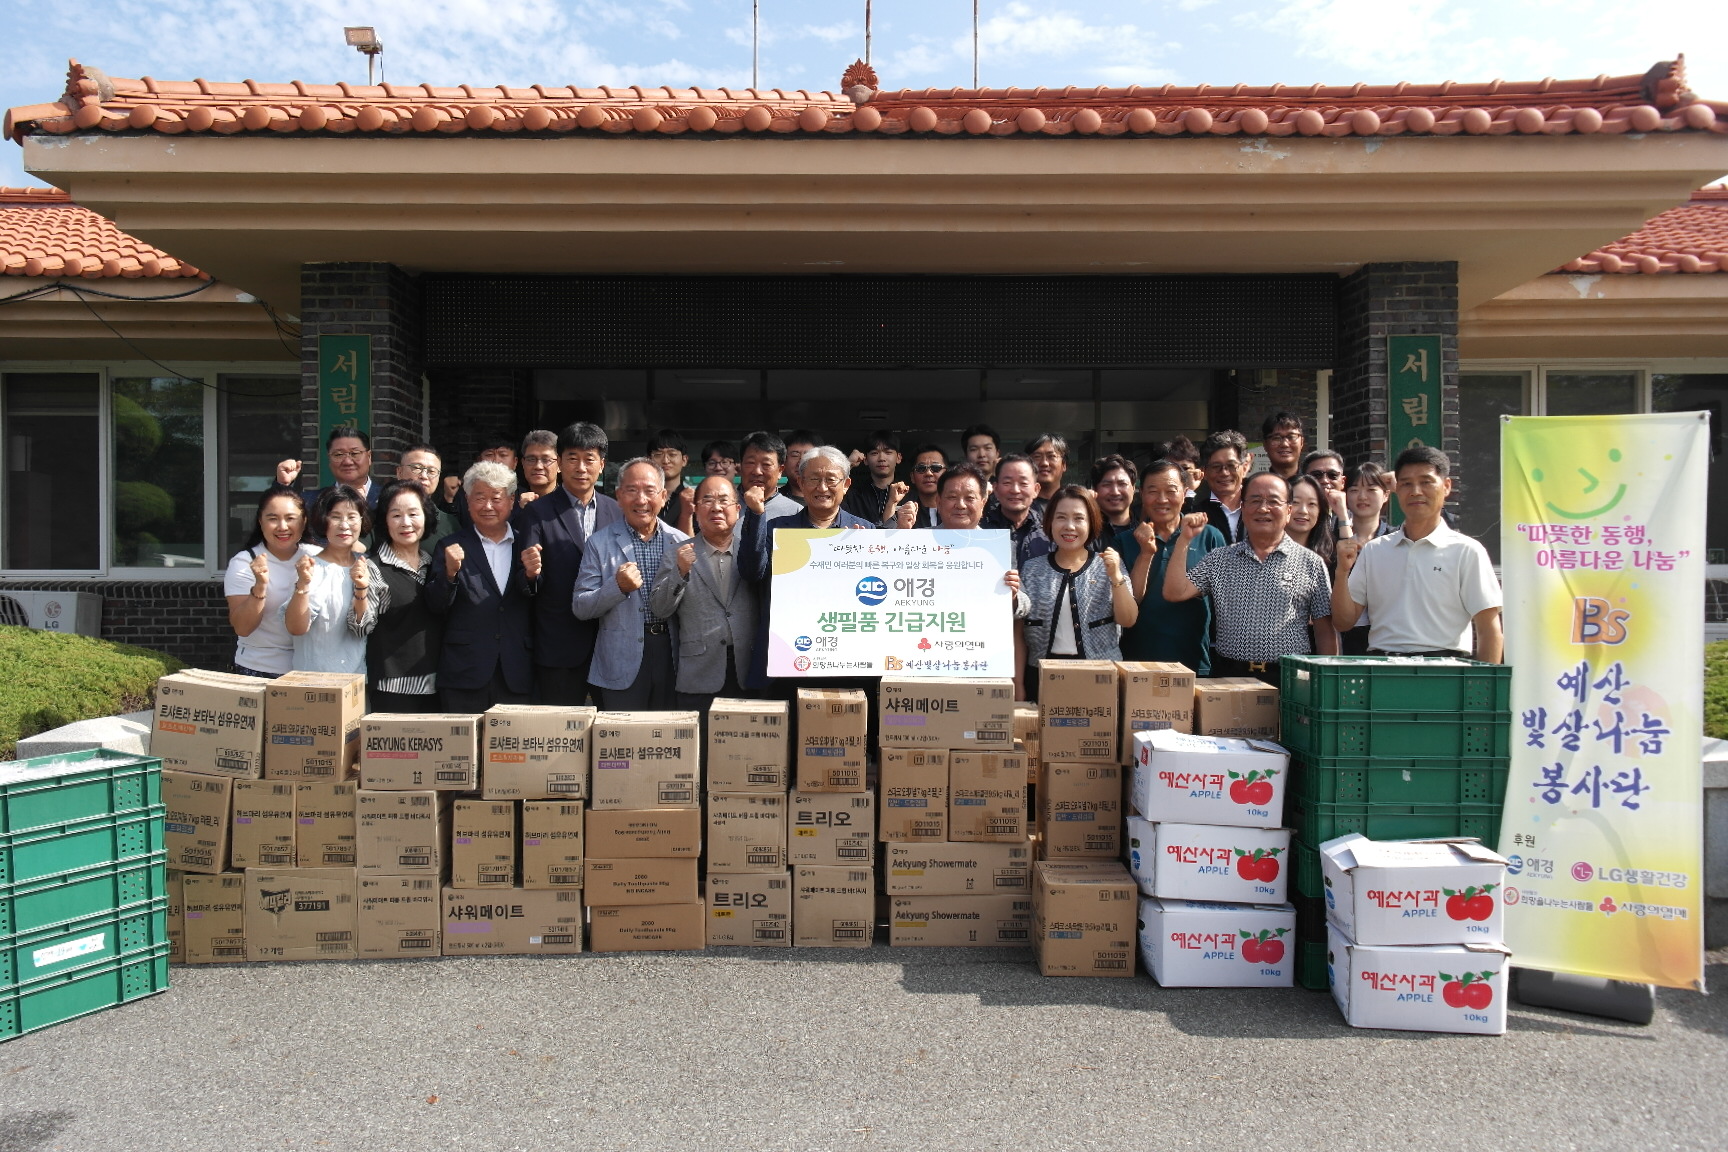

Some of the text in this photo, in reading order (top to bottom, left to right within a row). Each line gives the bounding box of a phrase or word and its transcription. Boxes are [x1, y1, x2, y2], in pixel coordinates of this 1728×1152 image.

[1400, 348, 1429, 449] 서림
[1517, 524, 1652, 547] “따뜻한 동행,
[810, 560, 831, 569] 수재민
[834, 560, 863, 570] 여러분의
[881, 560, 904, 570] 복구와
[905, 560, 920, 570] 일상
[922, 560, 944, 570] 회복을
[946, 560, 984, 570] 응원합니다
[1537, 549, 1691, 571] 아름다운 나눔”
[894, 577, 935, 598] 애경
[45, 621, 60, 629] LG
[817, 611, 966, 633] 생필품 긴급지원
[815, 636, 838, 647] 애경
[1557, 661, 1630, 705] 예산
[885, 697, 960, 713] 샤워메이트
[160, 704, 191, 722] 르샤트라
[192, 708, 217, 726] 보타닉
[217, 711, 256, 731] 섬유유연제
[1522, 707, 1670, 755] 빛살나눔
[366, 737, 443, 751] AEKYUNG KERASYS
[489, 736, 584, 753] 르샤트라 보타닉 섬유유연제
[599, 746, 681, 760] 르샤트라 섬유유연제
[1158, 771, 1225, 790] 예산사과
[1532, 762, 1650, 810] 봉사단
[1189, 790, 1222, 799] APPLE
[795, 810, 852, 828] 트리오
[1247, 809, 1269, 817] 10kg
[1514, 833, 1535, 848] 후원
[892, 858, 977, 869] Aekyung Showermate
[1167, 845, 1232, 866] 예산사과
[1198, 866, 1230, 876] APPLE
[1526, 858, 1553, 873] 애경
[1599, 867, 1688, 888] LG생활건강
[1254, 886, 1275, 895] 10kg
[1367, 889, 1440, 908] 예산사과
[298, 902, 326, 910] 377191
[713, 891, 769, 910] 트리오
[448, 904, 525, 920] 샤워메이트
[895, 910, 980, 922] Aekyung Showermate
[1402, 909, 1438, 918] APPLE
[1621, 903, 1687, 919] 사랑의열매
[1466, 925, 1489, 934] 10kg
[1171, 932, 1237, 950] 예산사과
[1203, 951, 1235, 960] APPLE
[1259, 968, 1281, 977] 10kg
[1361, 971, 1436, 993] 예산사과
[1396, 993, 1434, 1003] APPLE
[1464, 1014, 1488, 1023] 10kg
